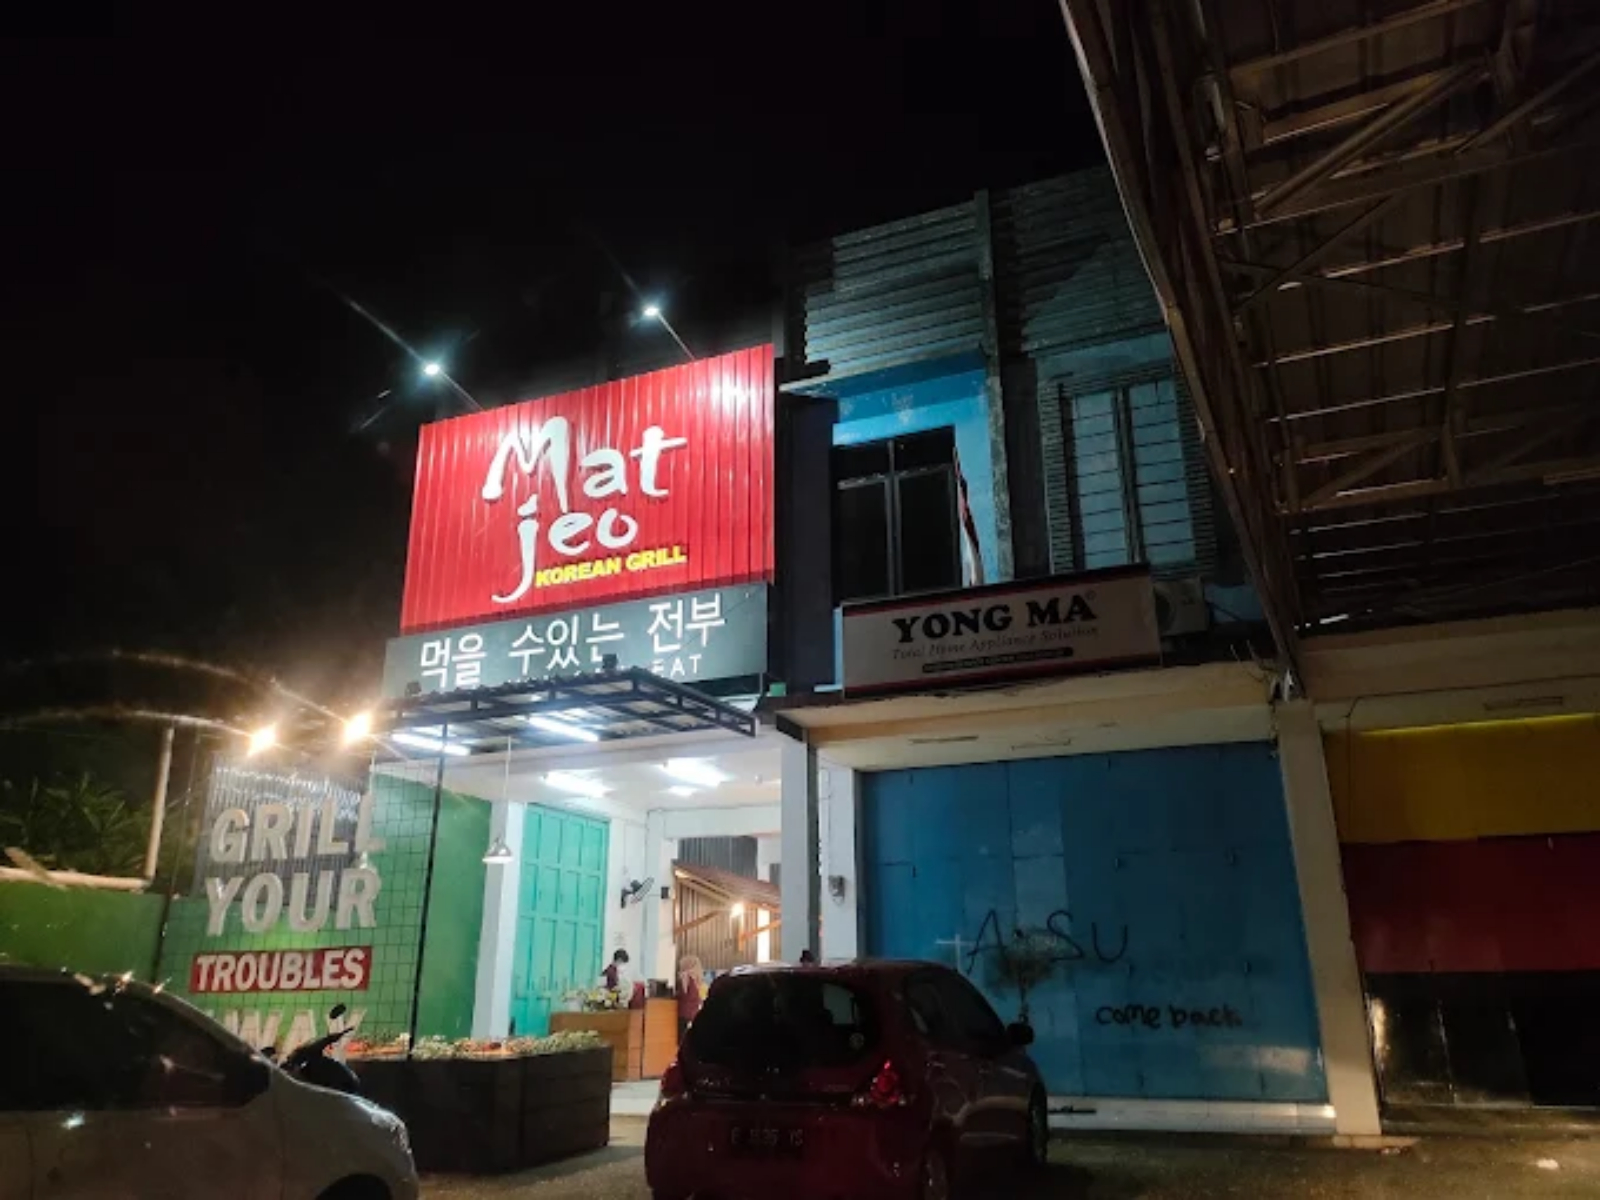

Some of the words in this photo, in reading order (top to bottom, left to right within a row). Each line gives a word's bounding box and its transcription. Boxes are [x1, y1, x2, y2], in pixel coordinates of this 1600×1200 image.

[481, 416, 687, 513] Mat
[492, 495, 638, 603] jeo
[535, 557, 621, 588] KOREAN
[626, 545, 687, 570] GRILL
[420, 633, 487, 688] 먹을
[508, 613, 625, 676] 수있는
[647, 593, 725, 653] 전부
[892, 604, 1013, 643] YONG
[1025, 594, 1097, 628] MA
[210, 793, 386, 862] GRILL
[205, 867, 382, 936] YOUR
[197, 948, 365, 991] TROUBLES
[207, 1009, 368, 1066] WAY
